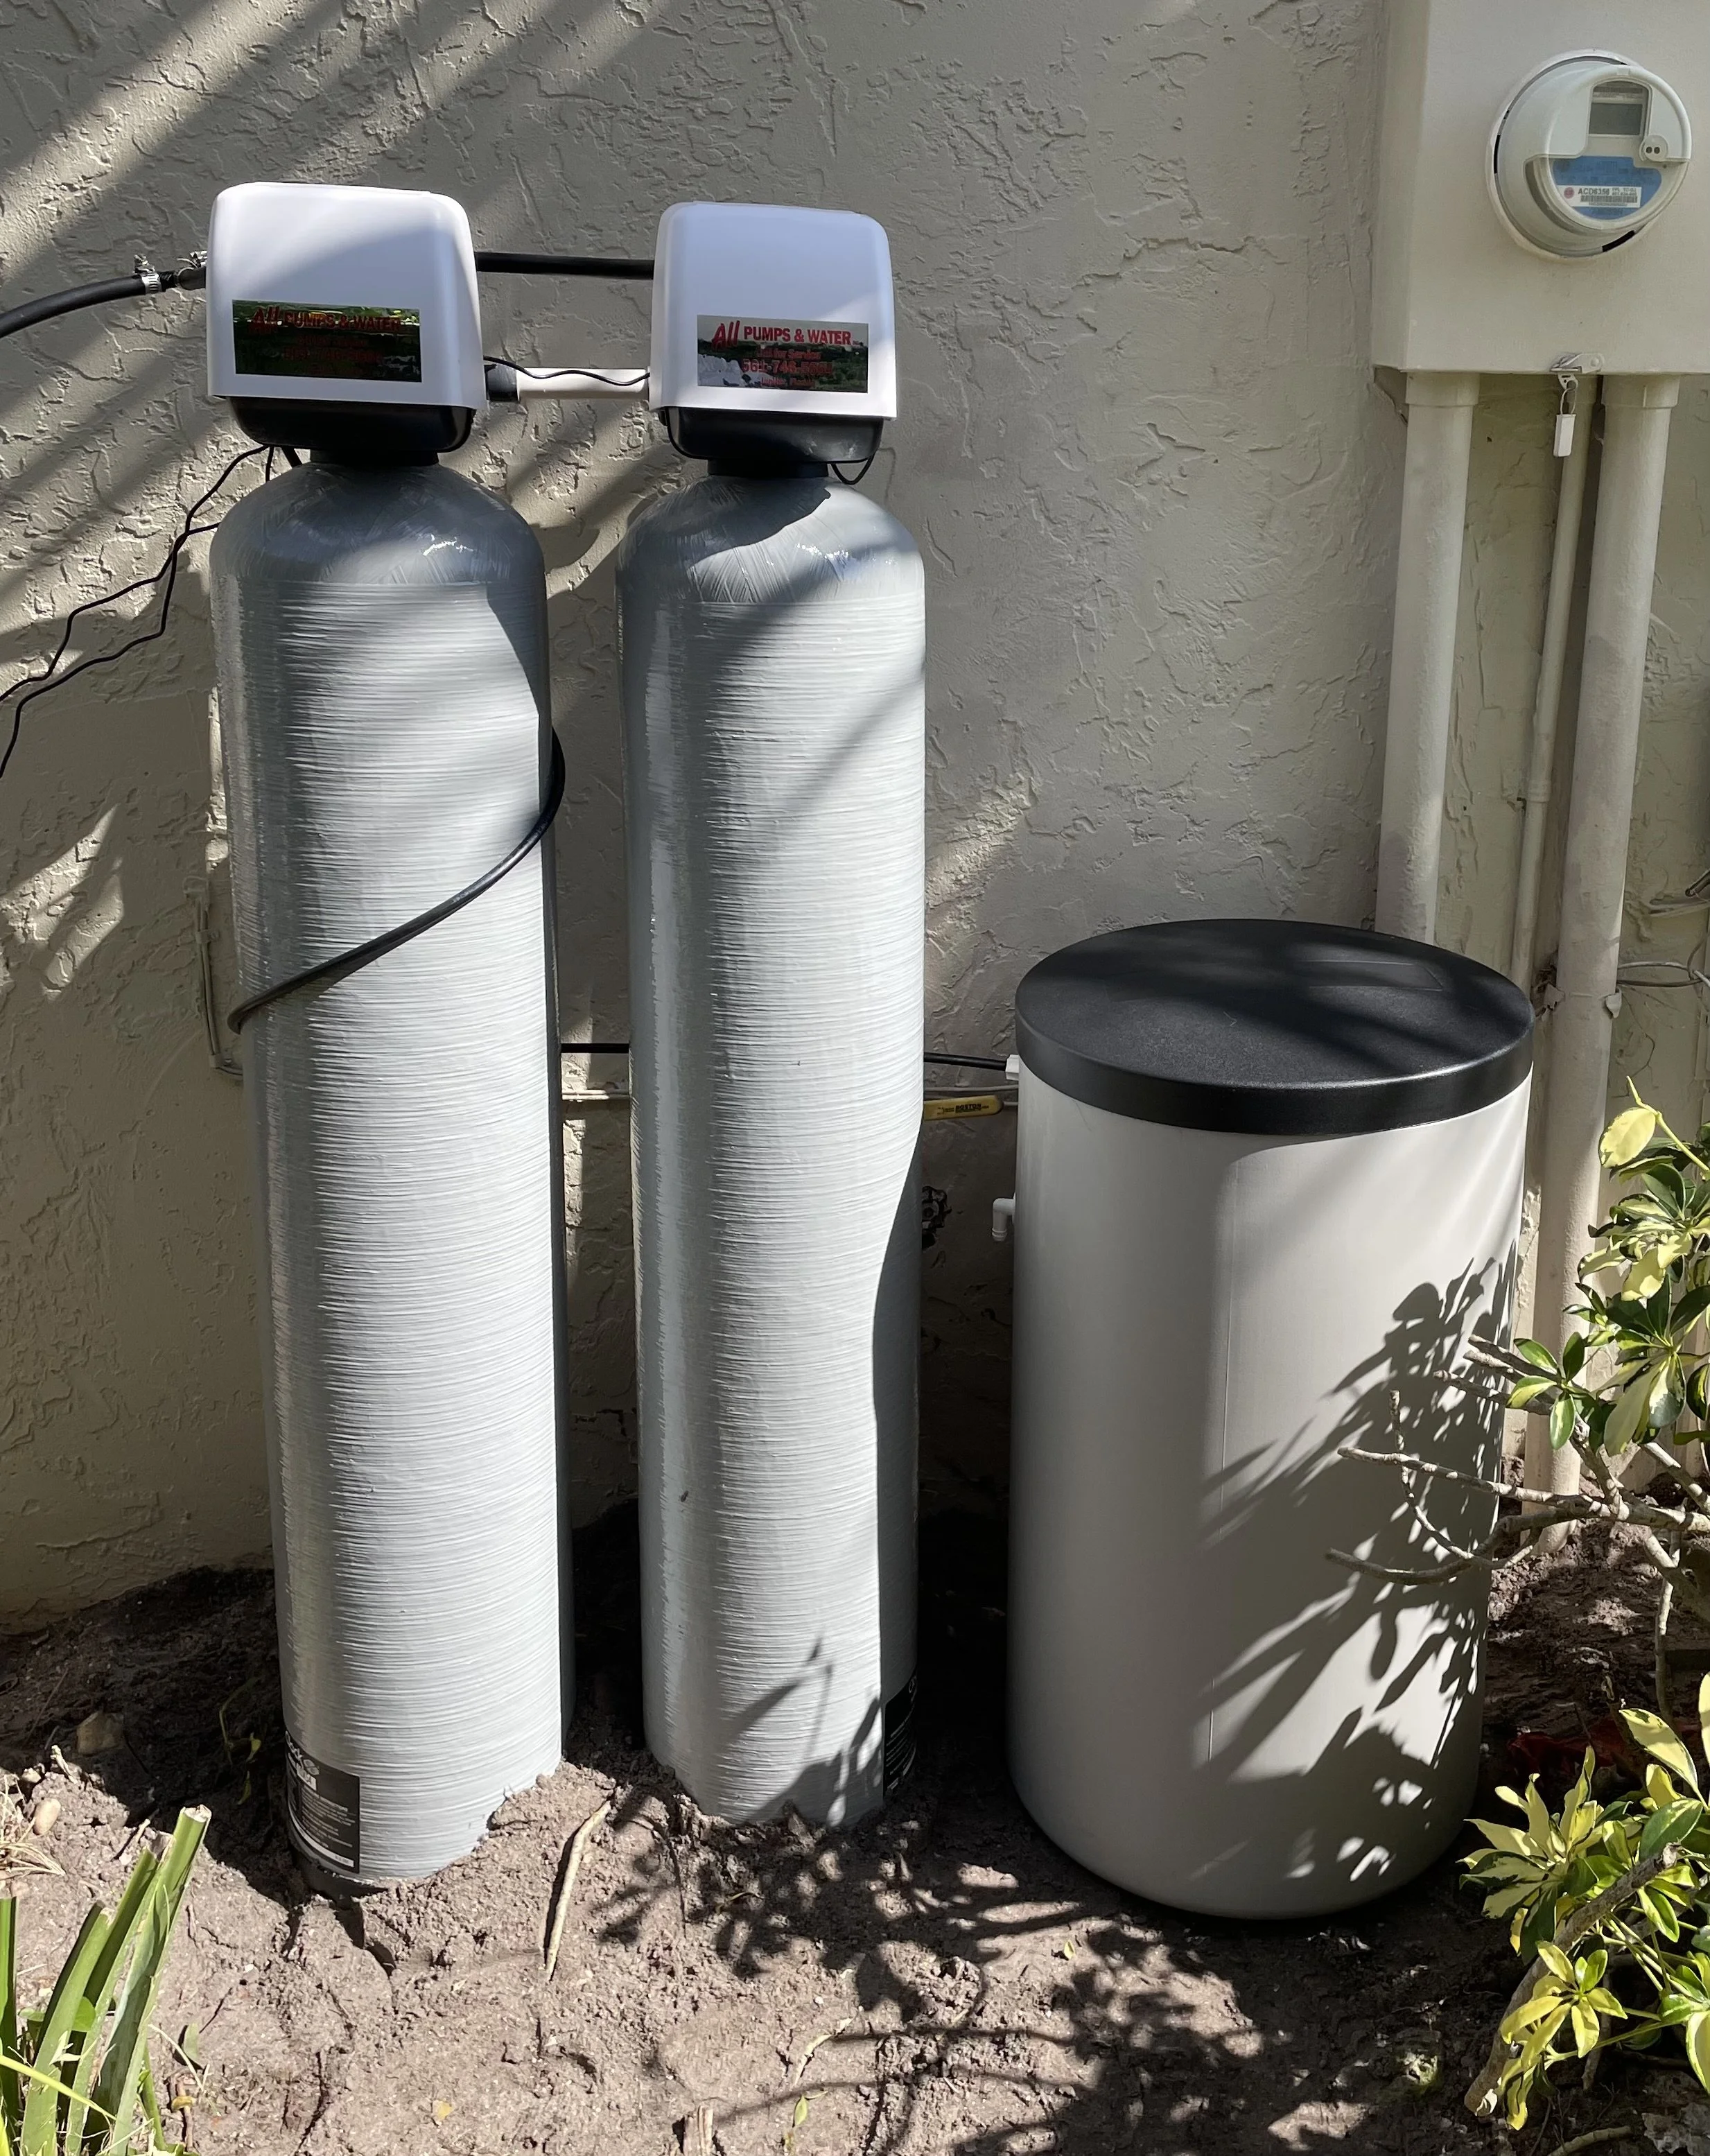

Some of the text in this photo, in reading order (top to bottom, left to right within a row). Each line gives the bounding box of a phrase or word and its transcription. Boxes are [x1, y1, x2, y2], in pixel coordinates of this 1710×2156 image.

[283, 312, 335, 328] PUMPS
[338, 315, 351, 329] &
[354, 316, 402, 331] WATER
[712, 320, 851, 348] All PUMPS & WATER
